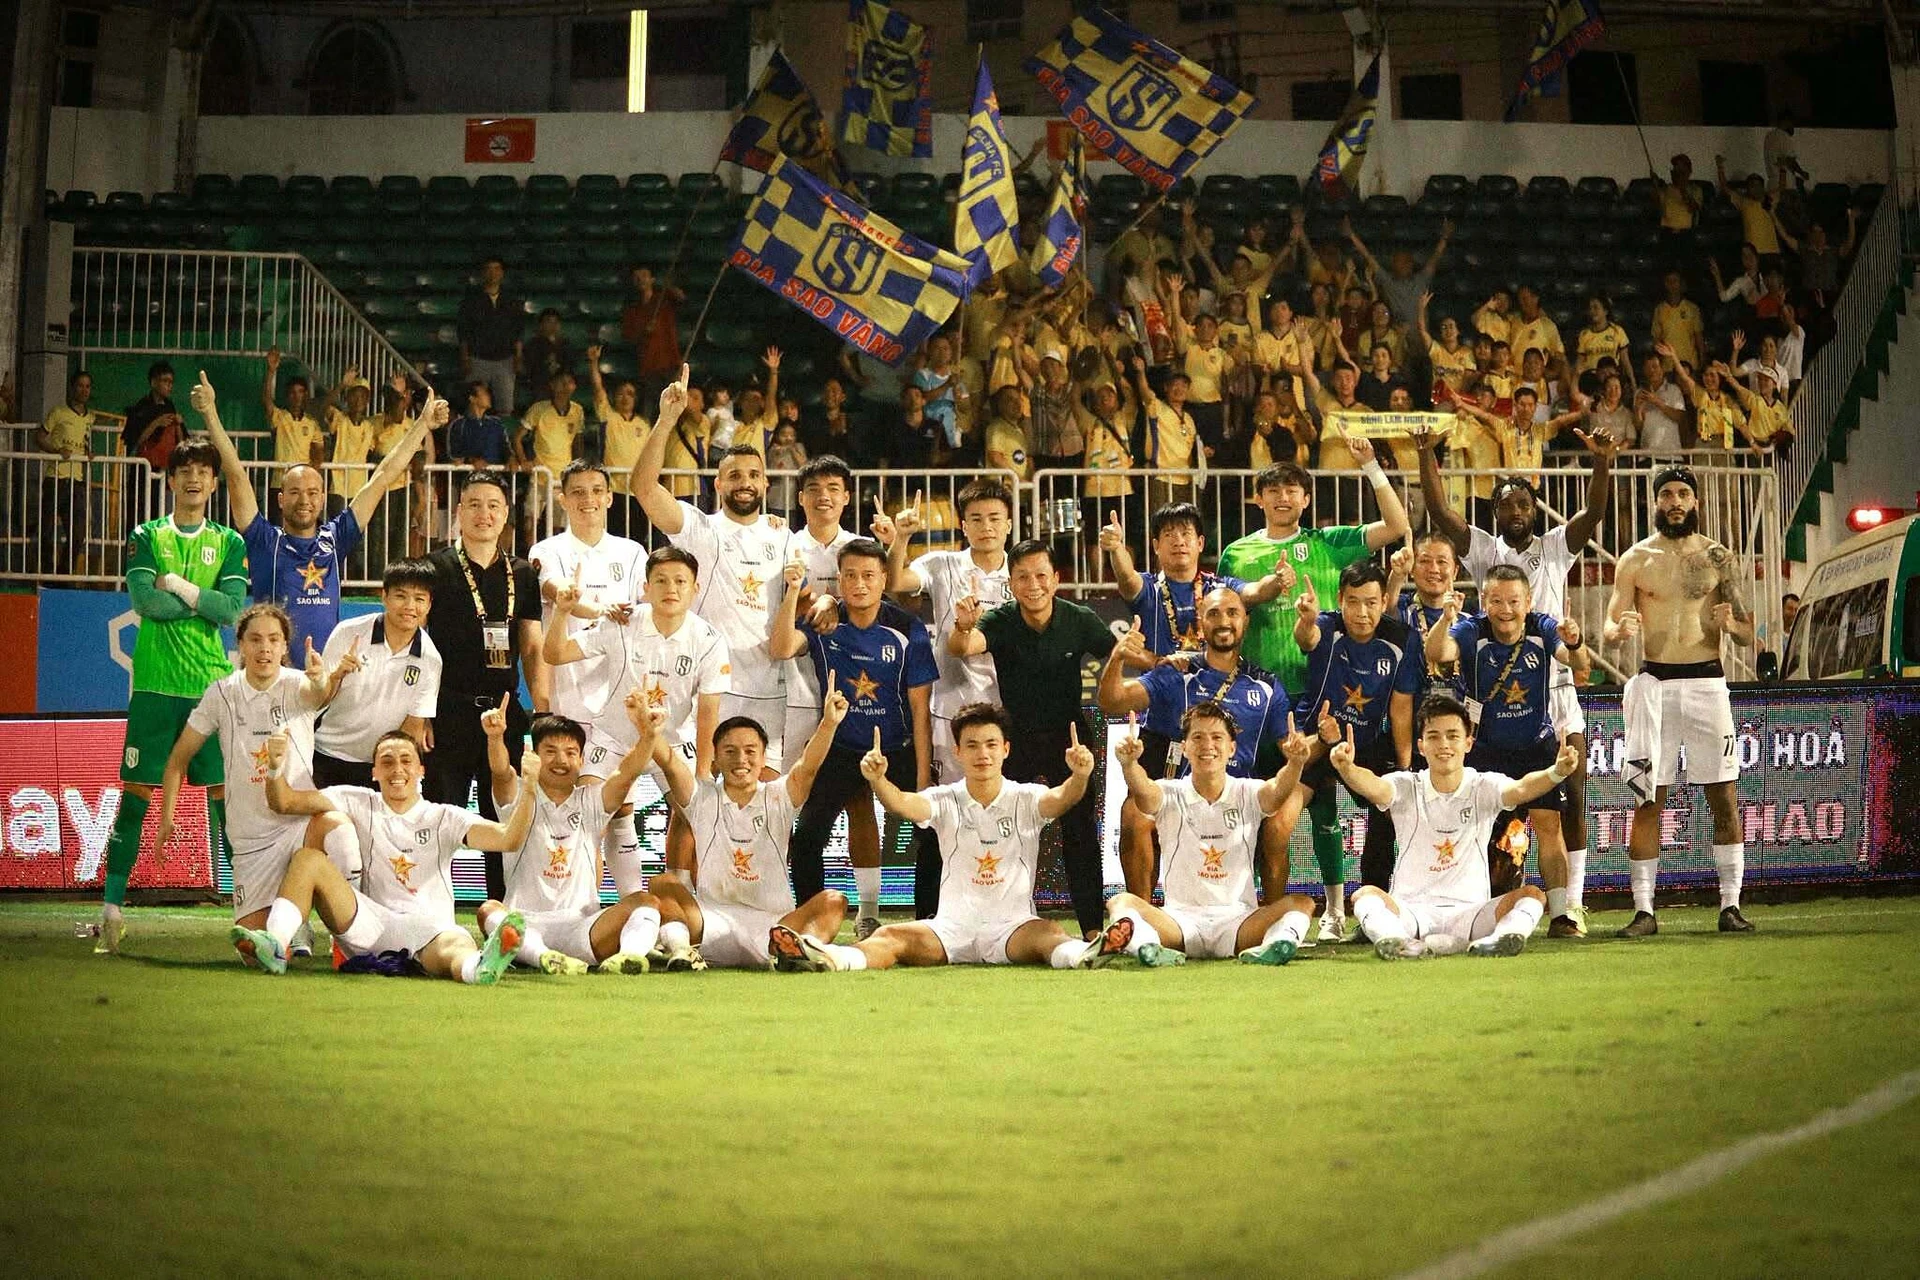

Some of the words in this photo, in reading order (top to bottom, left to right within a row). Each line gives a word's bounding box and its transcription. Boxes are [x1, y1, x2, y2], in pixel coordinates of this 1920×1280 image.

[1068, 105, 1115, 148] SAO
[781, 278, 836, 319] SAO
[308, 588, 320, 596] BIA
[296, 597, 312, 605] SAO
[859, 699, 873, 707] BIA
[1346, 706, 1359, 716] BIA
[1496, 711, 1513, 719] SAO
